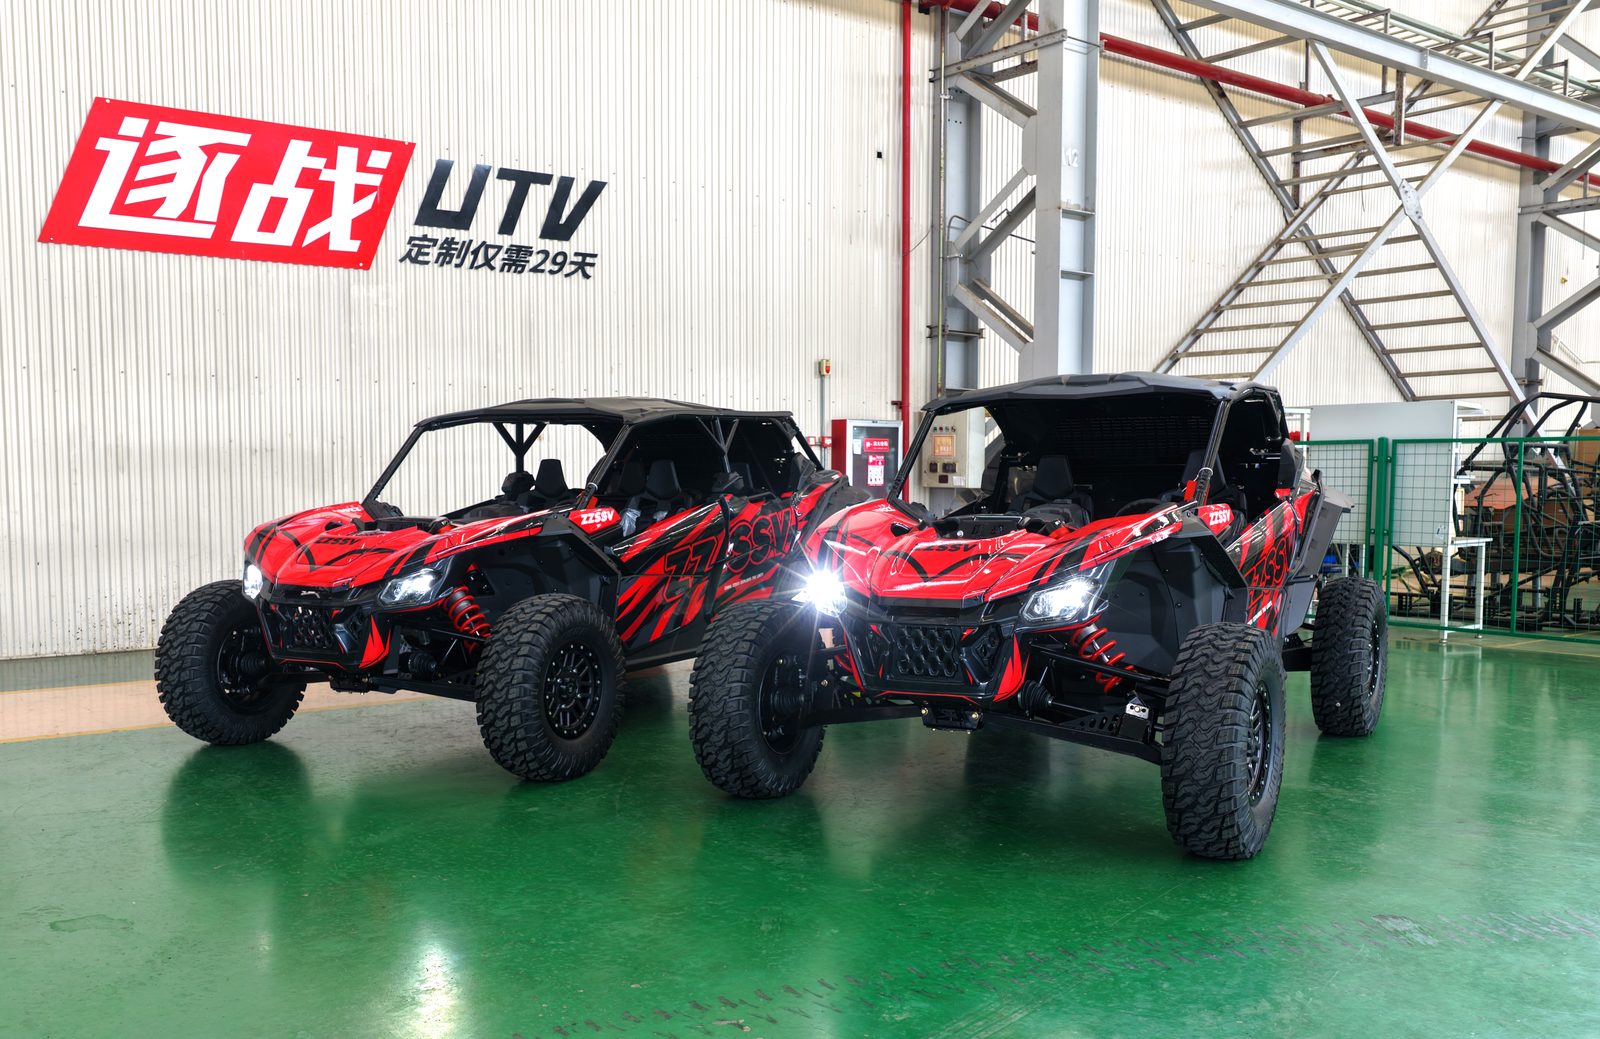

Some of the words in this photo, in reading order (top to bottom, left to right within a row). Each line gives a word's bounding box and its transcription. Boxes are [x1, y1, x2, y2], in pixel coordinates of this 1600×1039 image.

[78, 116, 392, 252] 逐战
[414, 159, 607, 241] UTV
[399, 234, 598, 279] 定制仅需29天
[580, 510, 615, 525] ZZSSV
